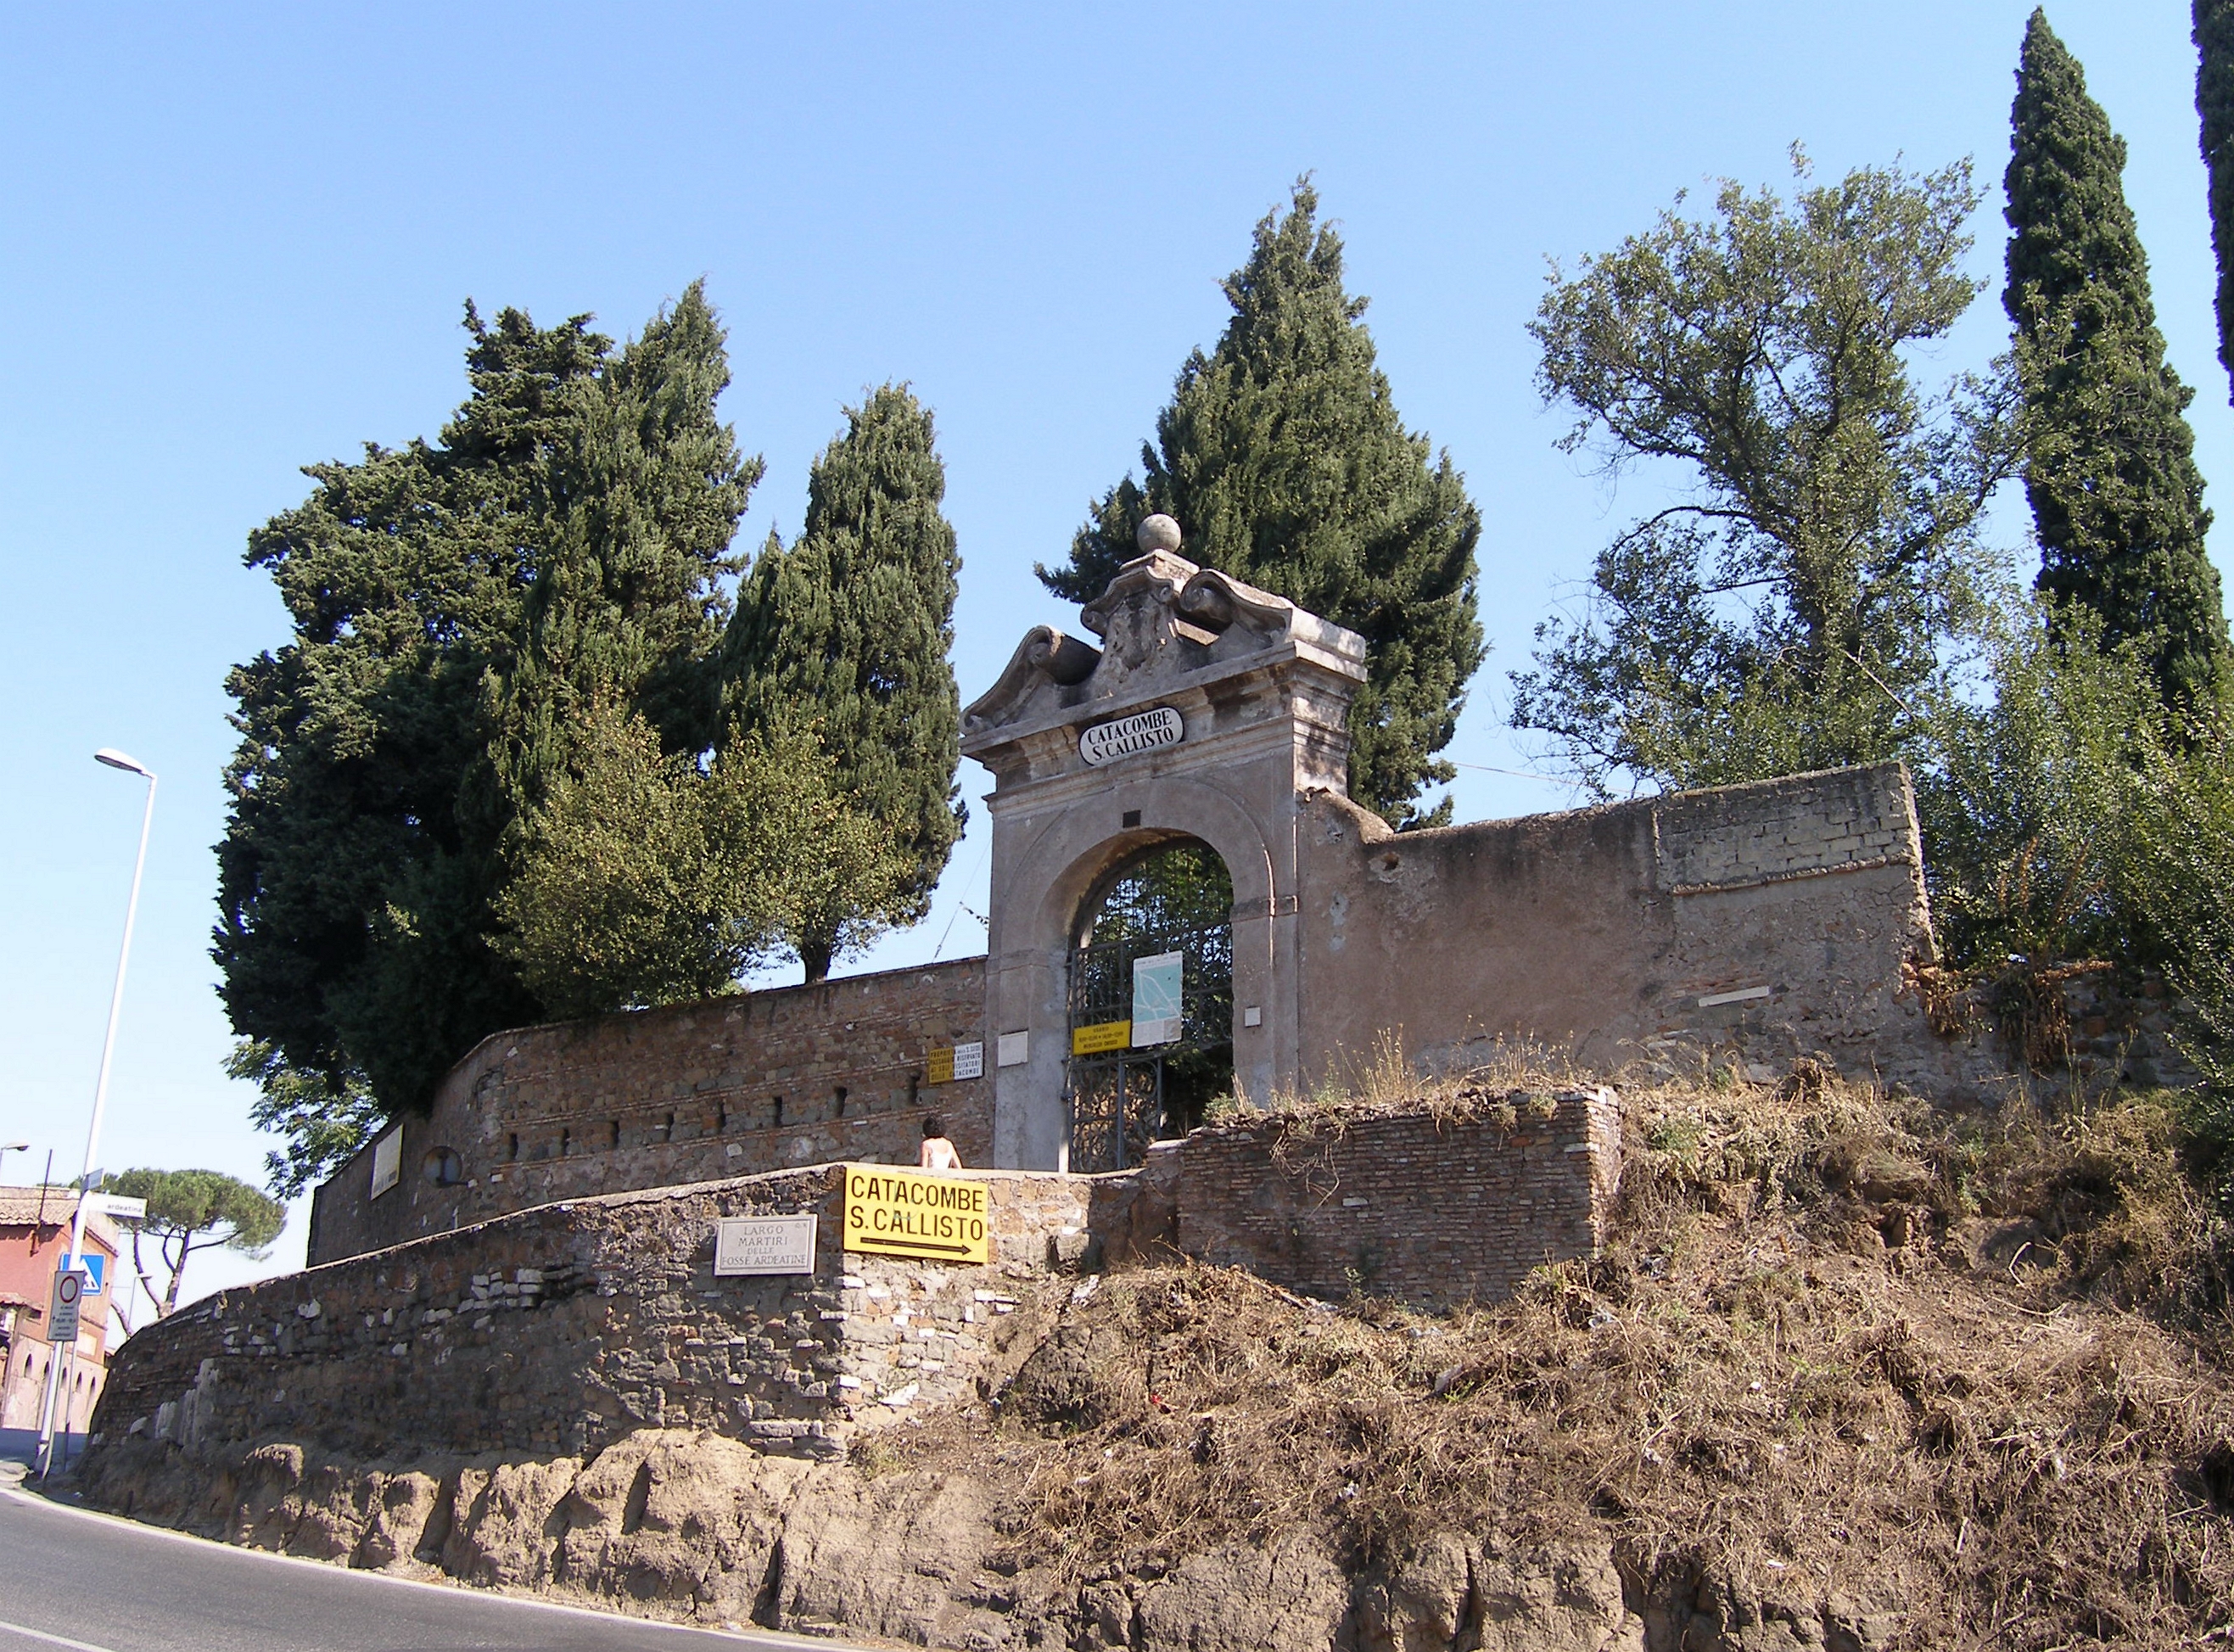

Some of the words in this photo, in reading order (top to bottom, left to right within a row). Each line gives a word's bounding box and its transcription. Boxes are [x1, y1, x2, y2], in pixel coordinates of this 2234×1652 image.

[1088, 709, 1172, 745] CATACOMBE
[851, 1175, 983, 1212] CATACOMBE
[107, 1203, 143, 1212] ardeatina
[743, 1225, 784, 1235] LARGO
[874, 1208, 983, 1241] CALLISTO
[738, 1236, 787, 1247] MARTIRI
[722, 1256, 751, 1266] FOSSE
[753, 1254, 806, 1265] ARDEATINE
